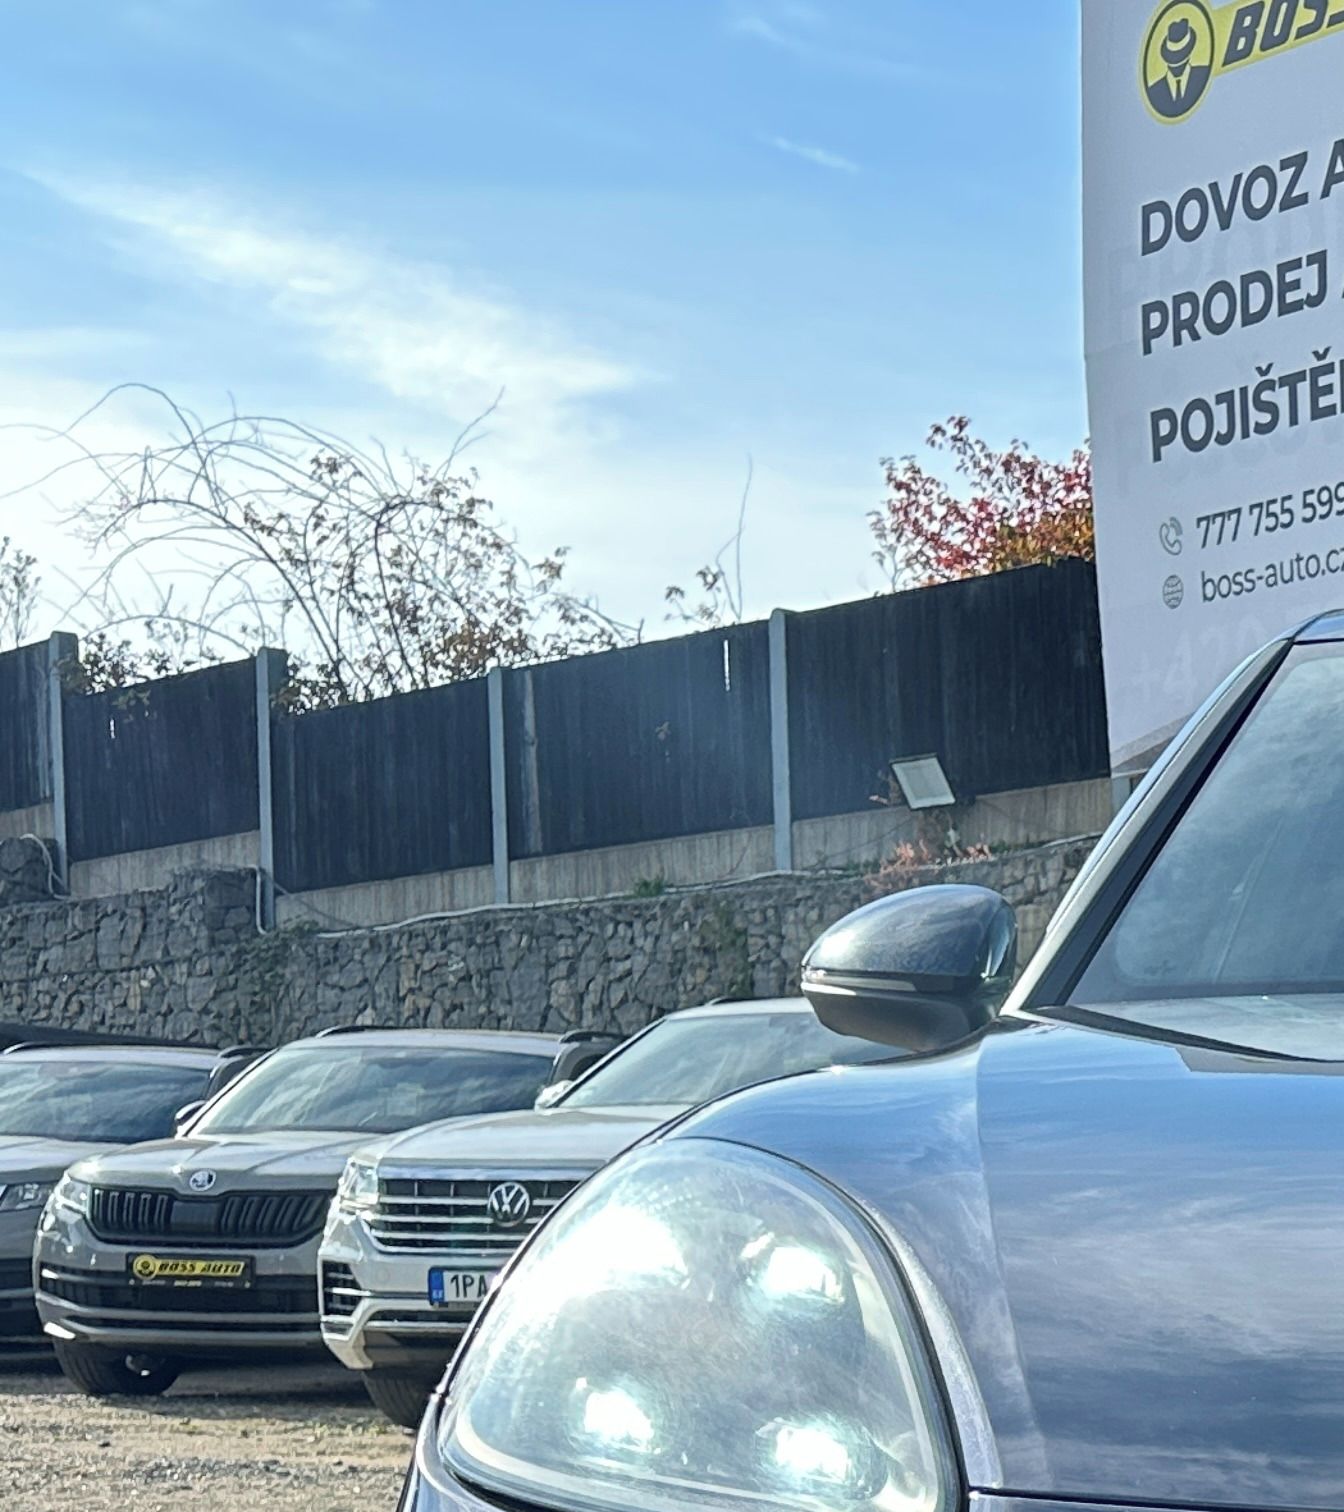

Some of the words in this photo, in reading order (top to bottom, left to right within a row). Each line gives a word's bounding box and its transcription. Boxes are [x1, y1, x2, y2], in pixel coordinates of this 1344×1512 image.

[1141, 151, 1310, 257] DOVOZ
[1141, 248, 1328, 356] PRODEJ
[1196, 506, 1242, 550] 777
[1249, 494, 1295, 538] 755
